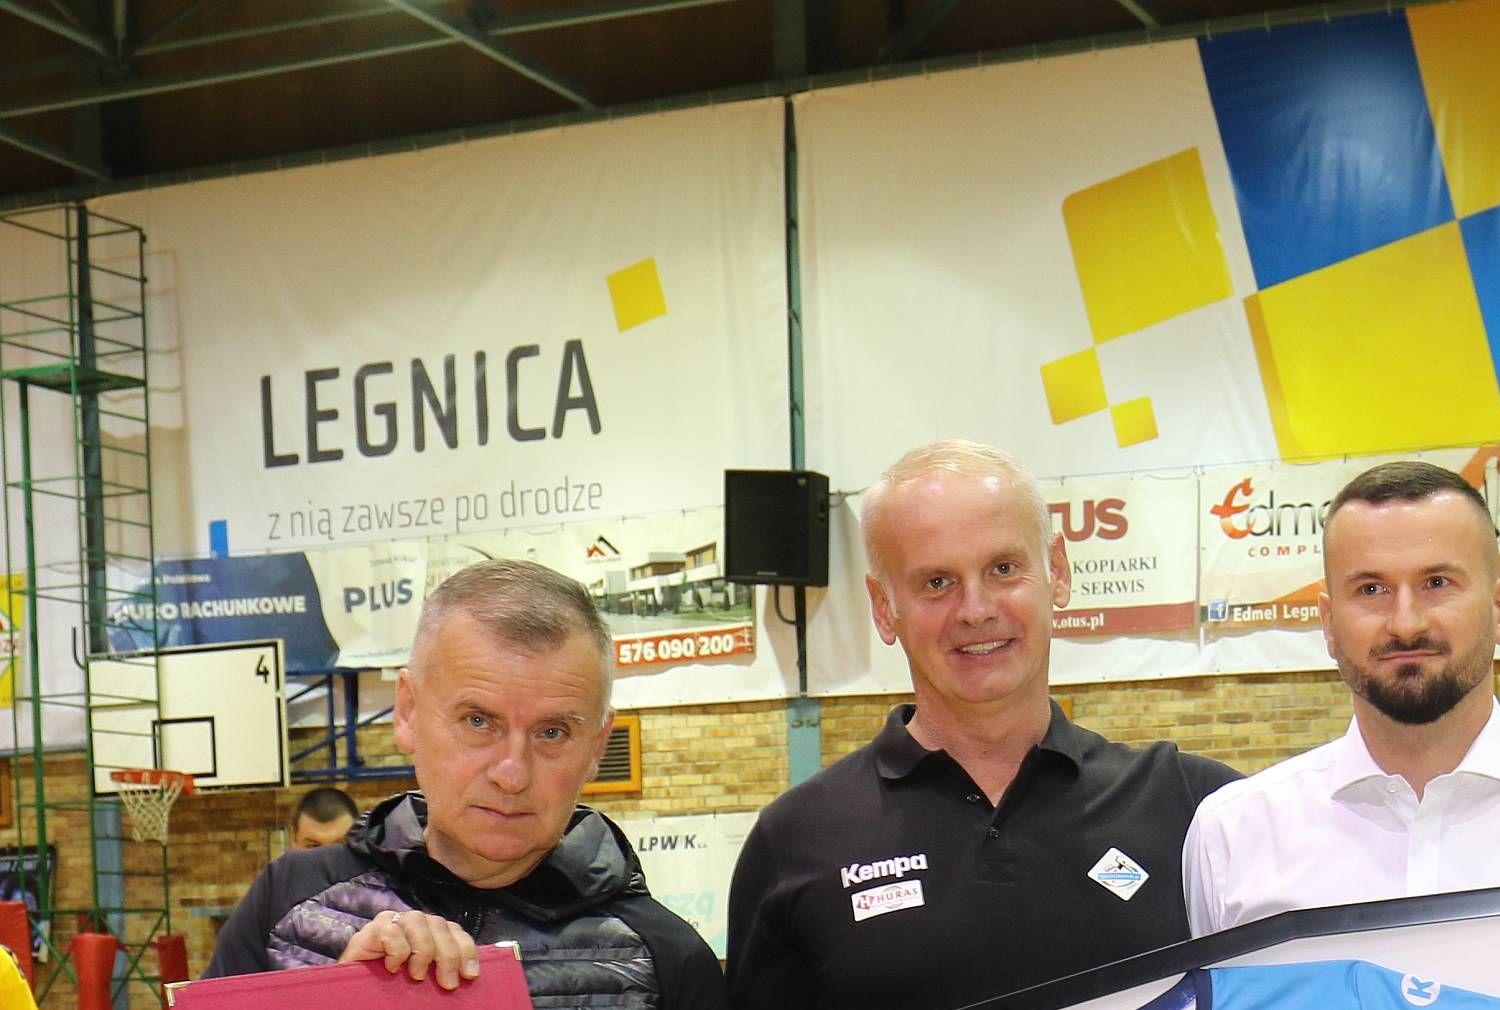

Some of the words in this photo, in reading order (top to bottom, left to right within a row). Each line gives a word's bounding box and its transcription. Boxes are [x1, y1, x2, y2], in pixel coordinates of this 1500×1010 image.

[260, 338, 602, 468] LEGNICA
[268, 512, 281, 540] z
[290, 500, 334, 541] nią
[341, 496, 446, 534] zawsze
[456, 492, 489, 535] po
[500, 475, 603, 519] drodze
[1047, 498, 1129, 542] TUS
[1073, 556, 1158, 574] KOPIARKI
[1247, 545, 1322, 558] COMPL
[343, 578, 414, 613] PLUS
[1081, 580, 1146, 597] SERWIS
[181, 595, 307, 619] RACHUNKOWE
[1233, 604, 1277, 622] Edmel
[1283, 604, 1320, 624] Legn
[619, 641, 656, 664] 576
[658, 637, 696, 660] 090
[699, 633, 734, 656] 200
[255, 654, 270, 684] 4
[840, 853, 929, 889] Kempa
[876, 887, 919, 904] HURAS
